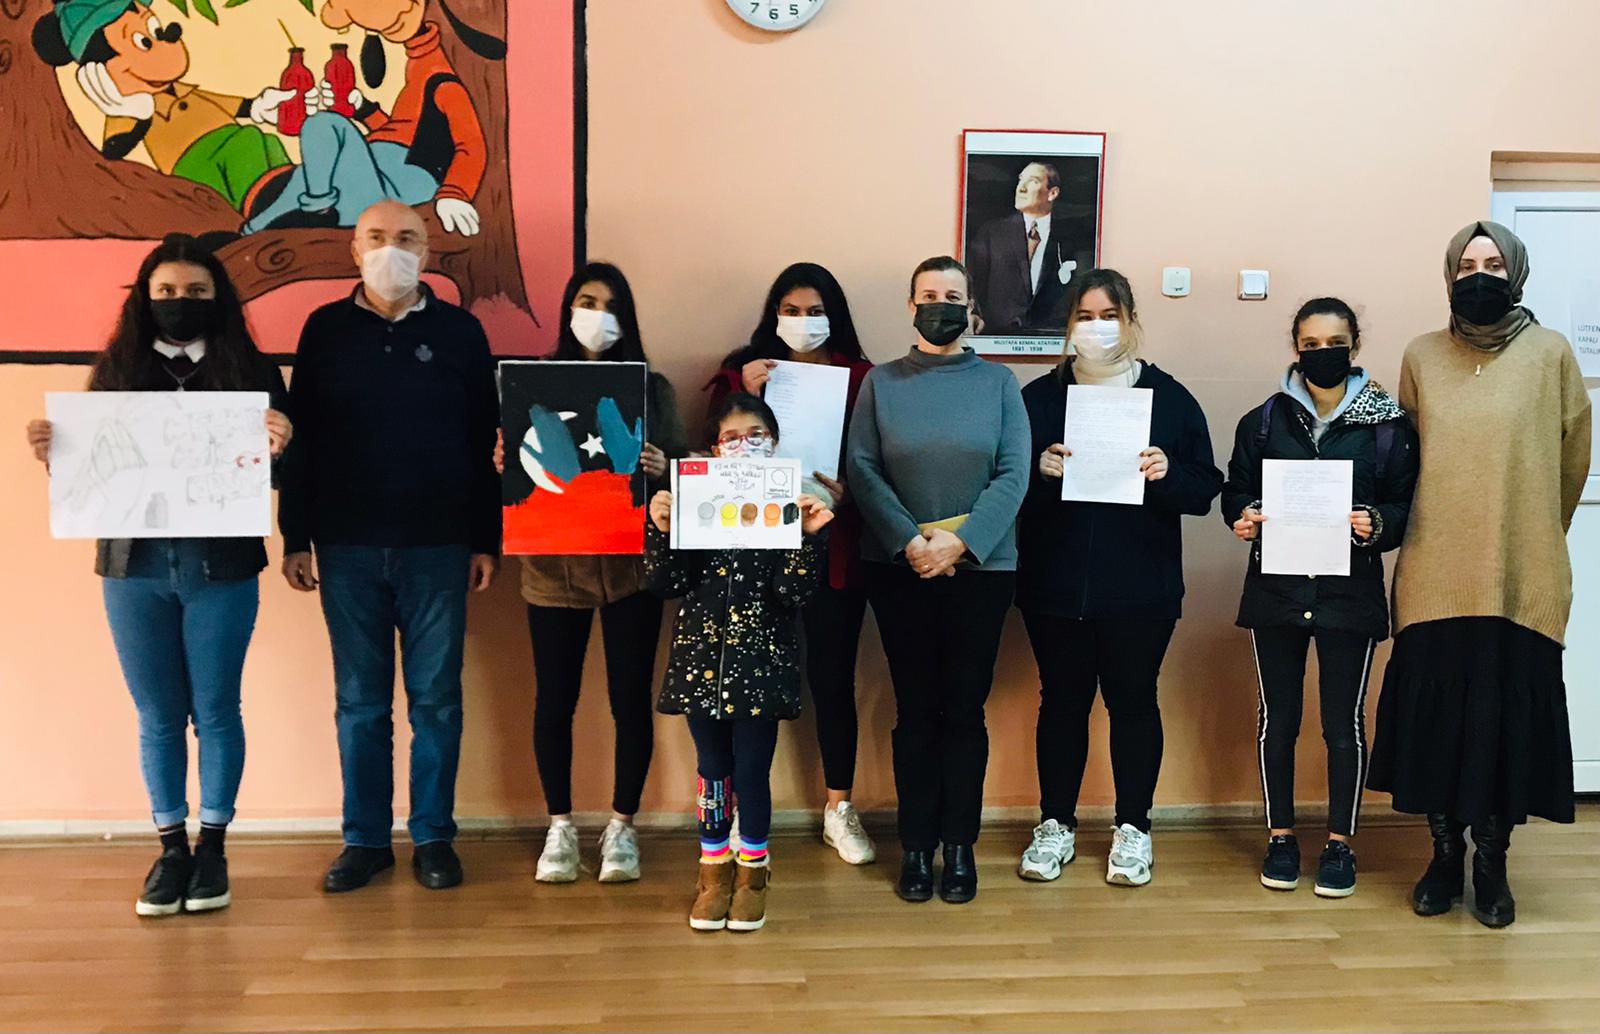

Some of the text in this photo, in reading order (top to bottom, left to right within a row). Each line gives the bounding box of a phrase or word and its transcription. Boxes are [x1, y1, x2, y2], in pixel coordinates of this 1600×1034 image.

[750, 2, 760, 14] 7
[769, 8, 779, 20] 6
[789, 4, 799, 15] 5
